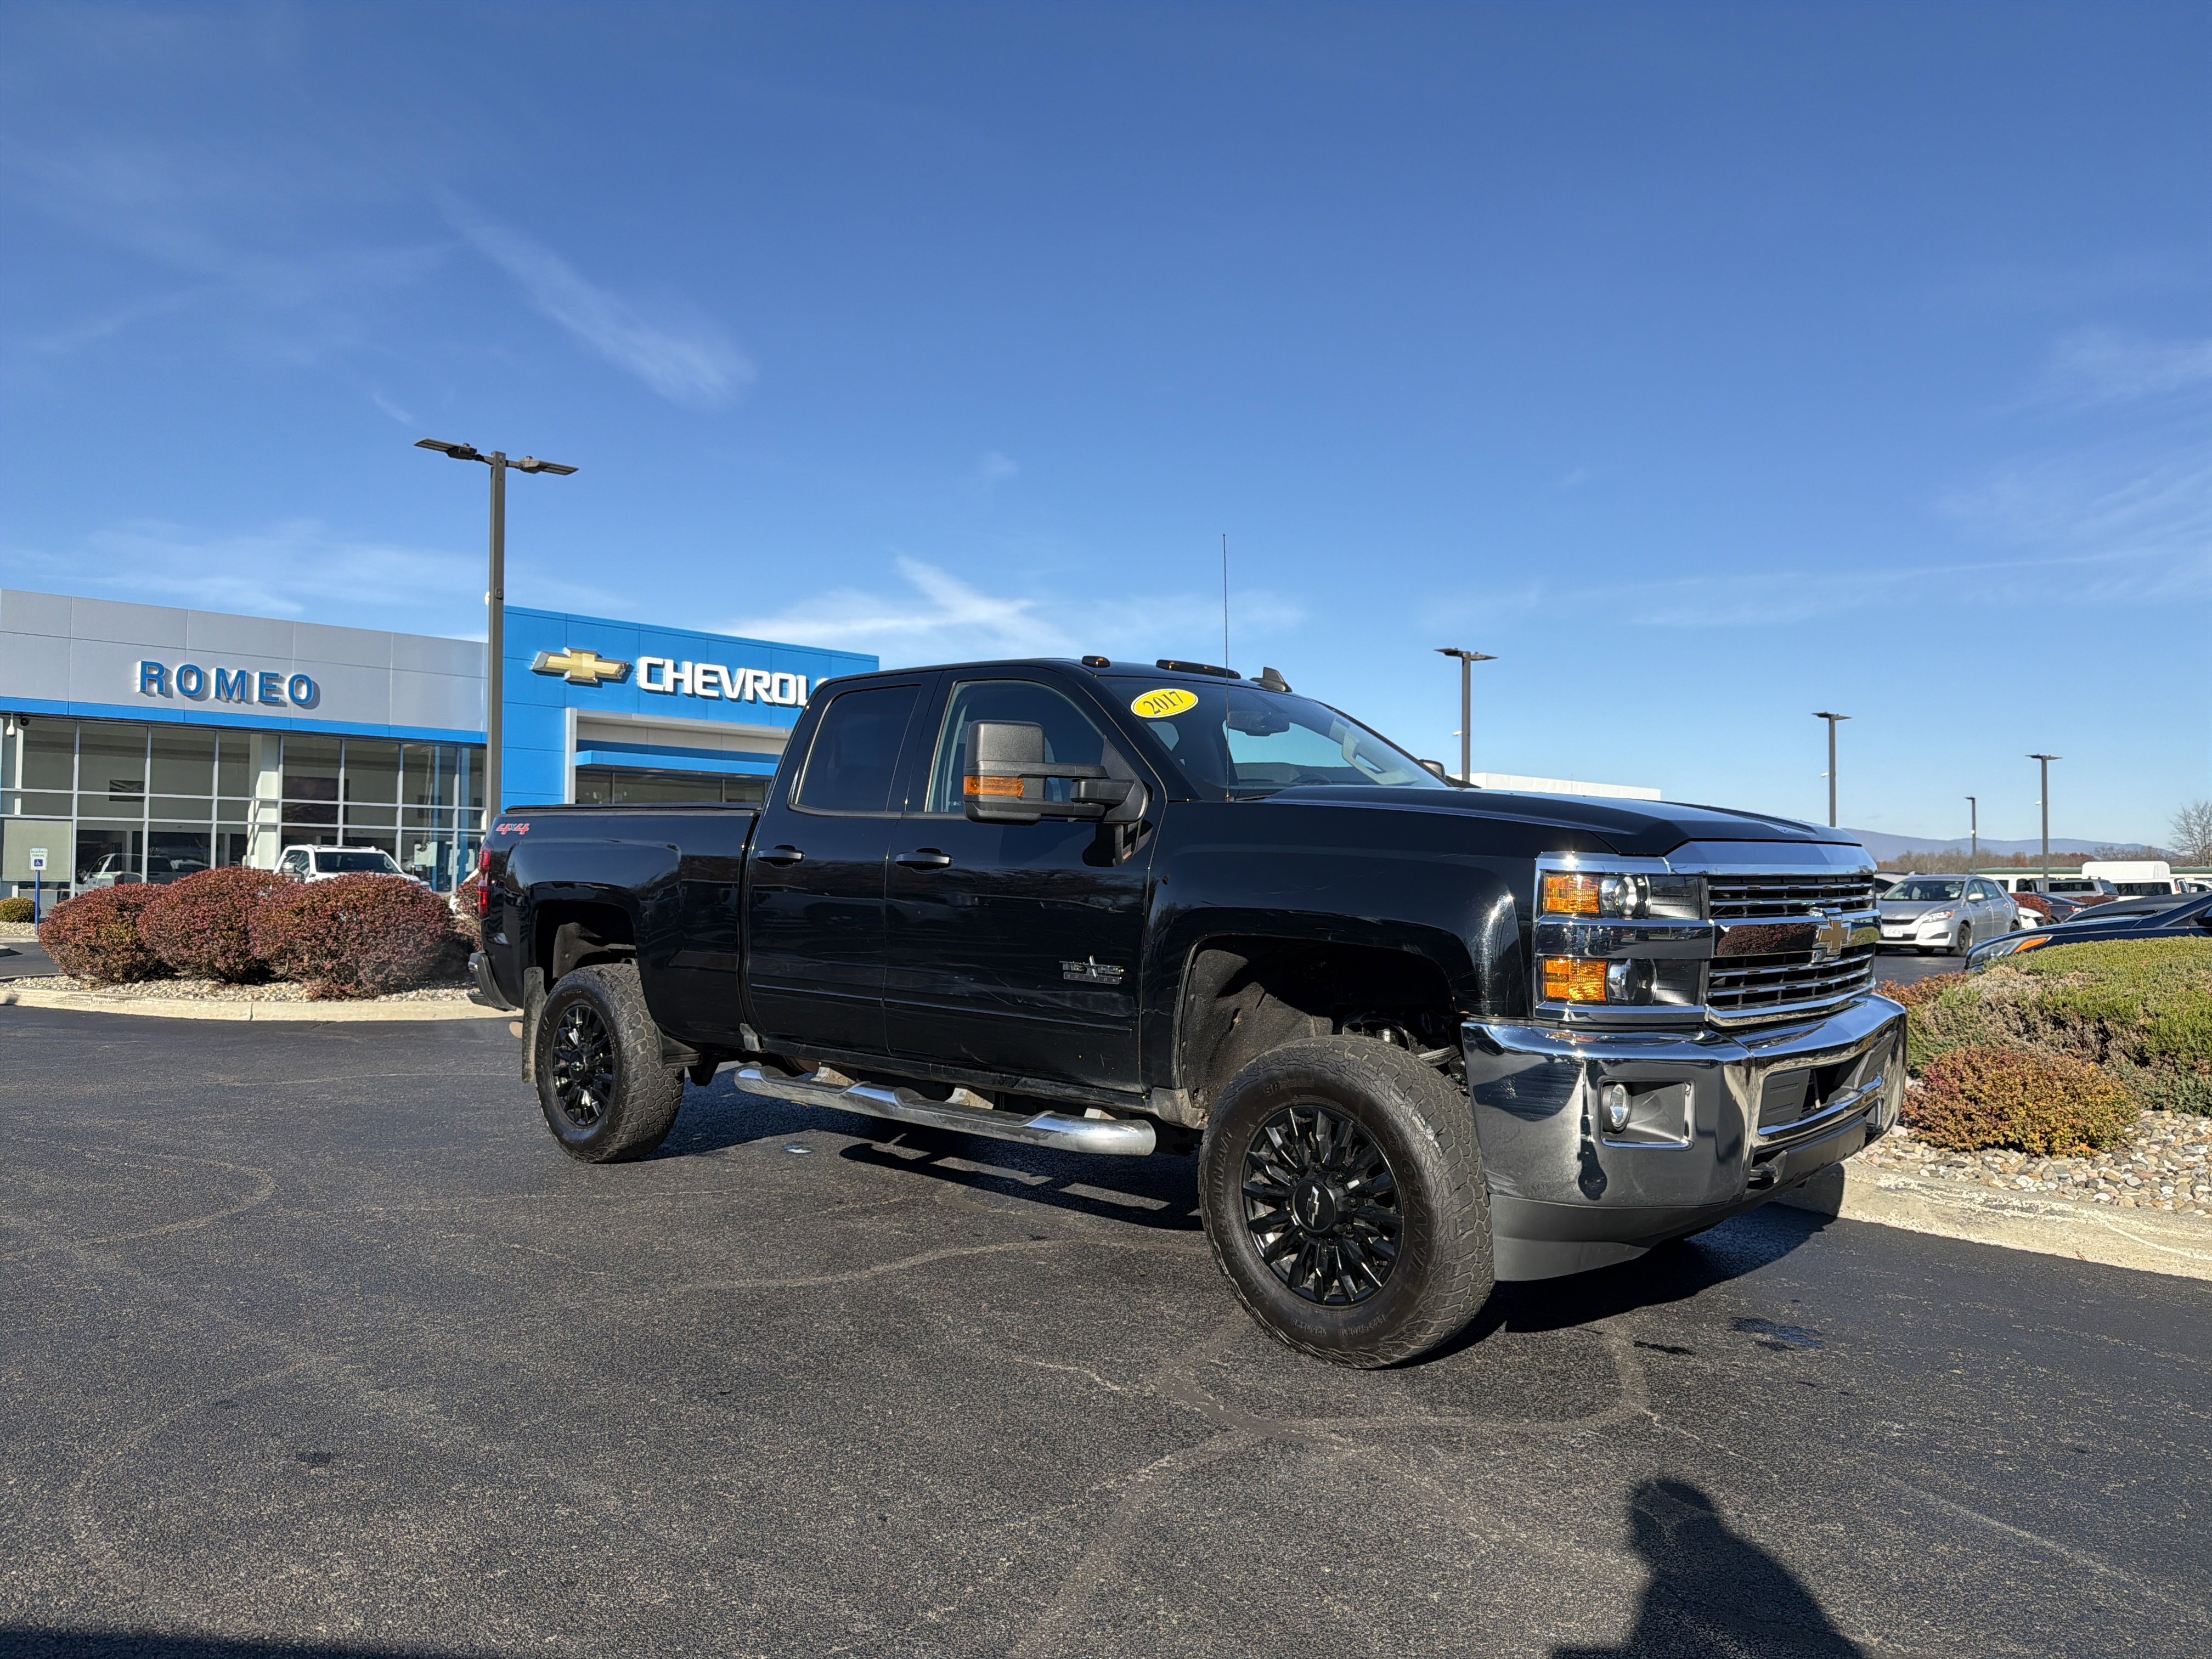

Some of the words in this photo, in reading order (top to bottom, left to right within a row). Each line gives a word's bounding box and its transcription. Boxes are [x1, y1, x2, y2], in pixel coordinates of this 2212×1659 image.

[139, 660, 314, 704] ROMEO
[637, 656, 828, 707] CHEVROL
[1143, 691, 1184, 715] 2017
